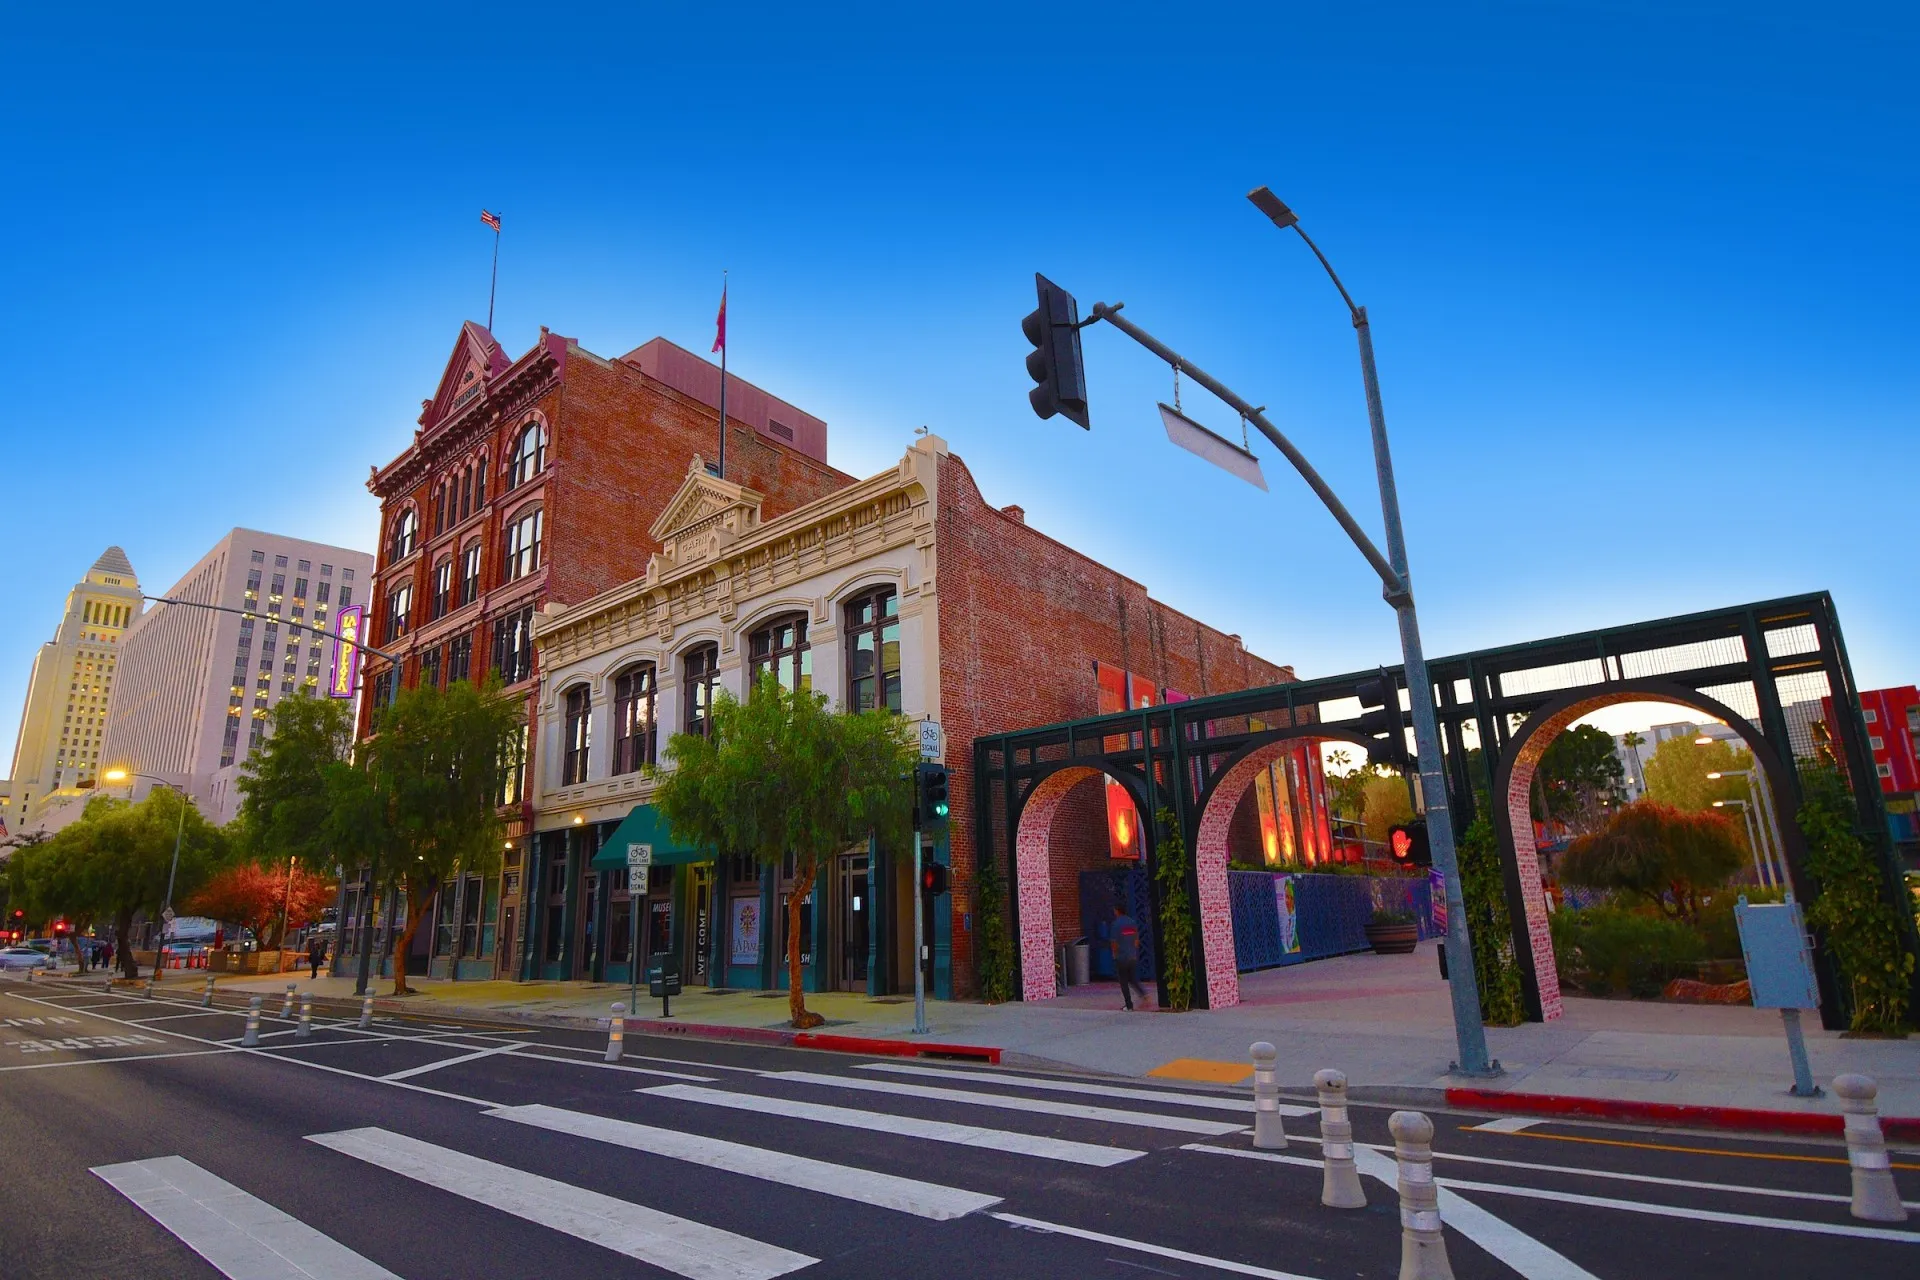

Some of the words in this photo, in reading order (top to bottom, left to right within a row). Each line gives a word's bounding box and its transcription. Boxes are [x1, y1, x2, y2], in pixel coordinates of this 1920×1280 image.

[921, 743, 938, 752] SIGNAL
[630, 883, 646, 891] SIGNAL
[698, 908, 706, 975] WELCOME
